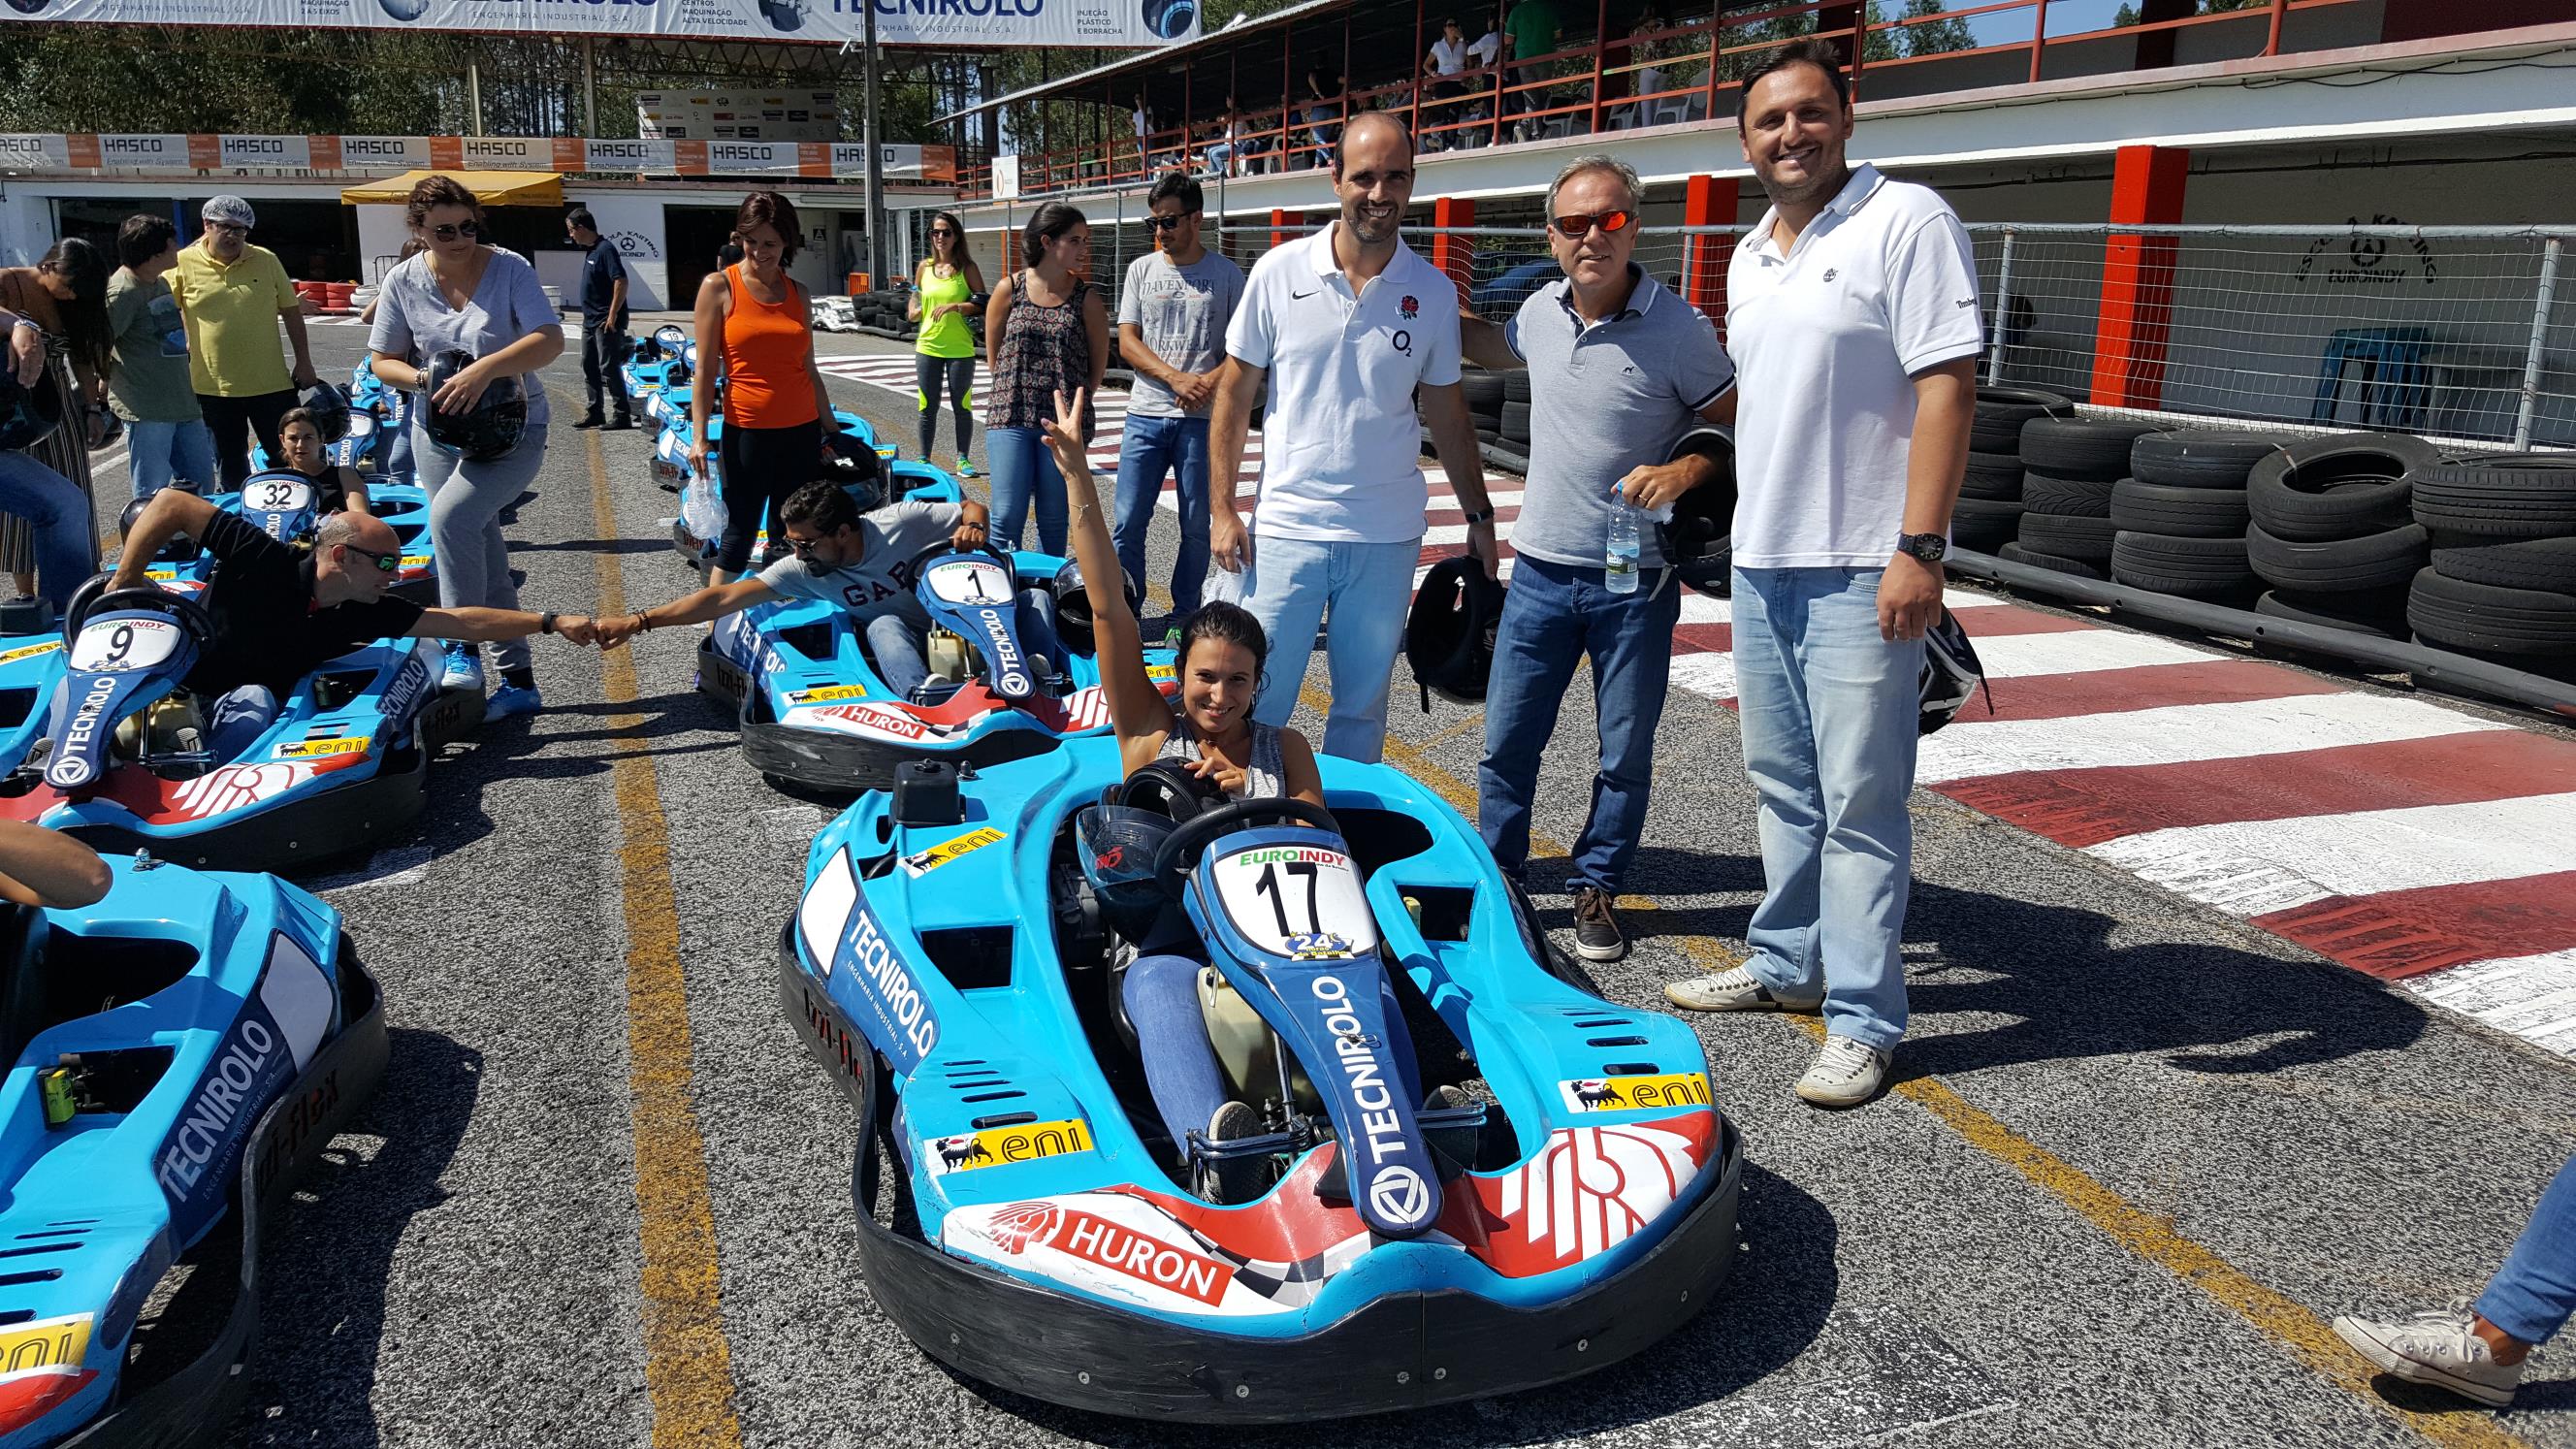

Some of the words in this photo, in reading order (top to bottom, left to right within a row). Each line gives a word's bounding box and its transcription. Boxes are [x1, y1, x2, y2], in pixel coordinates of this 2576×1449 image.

[472, 12, 539, 20] ENGENHARIA
[1077, 9, 1109, 17] INJEÇÃO
[854, 23, 921, 32] EENHARIA
[0, 139, 42, 152] ASCO
[104, 139, 163, 152] HASCO
[224, 139, 283, 153] HASCO
[345, 141, 404, 154] HASCO
[467, 142, 527, 155] HASCO
[590, 144, 648, 158] HASCO
[713, 145, 773, 160] HASCO
[836, 148, 895, 163] HASO
[467, 160, 500, 169] Enabling
[590, 162, 624, 171] Enabling
[627, 230, 660, 258] KARTING
[2328, 269, 2407, 283] EUROINDY
[263, 483, 293, 505] 32
[145, 570, 172, 580] ni
[940, 563, 999, 572] EUROINDY
[967, 569, 984, 597] 1
[89, 621, 167, 632] EUROINDY
[106, 626, 135, 661] 9
[980, 609, 1020, 672] TECNIROLO
[821, 684, 865, 702] eni
[63, 676, 117, 757] TECNIROLO
[849, 706, 920, 738] HURON
[314, 737, 364, 755] eni
[949, 826, 1005, 854] eni
[1240, 850, 1347, 866] EUROINDY
[1255, 861, 1322, 937] 17
[1294, 934, 1334, 950] 24
[850, 910, 934, 1058] TECNIROLO
[847, 959, 874, 1004] ENGENHARIA
[873, 1000, 898, 1046] INDUSTRIAL,
[898, 1043, 909, 1060] S.A.
[1311, 976, 1406, 1165] TECNIROLO
[1631, 1073, 1711, 1110] eni
[159, 1019, 273, 1203] TECNIROLO
[1002, 1118, 1083, 1162] eni
[1068, 1217, 1217, 1297] HURON
[0, 1321, 77, 1373] ni
